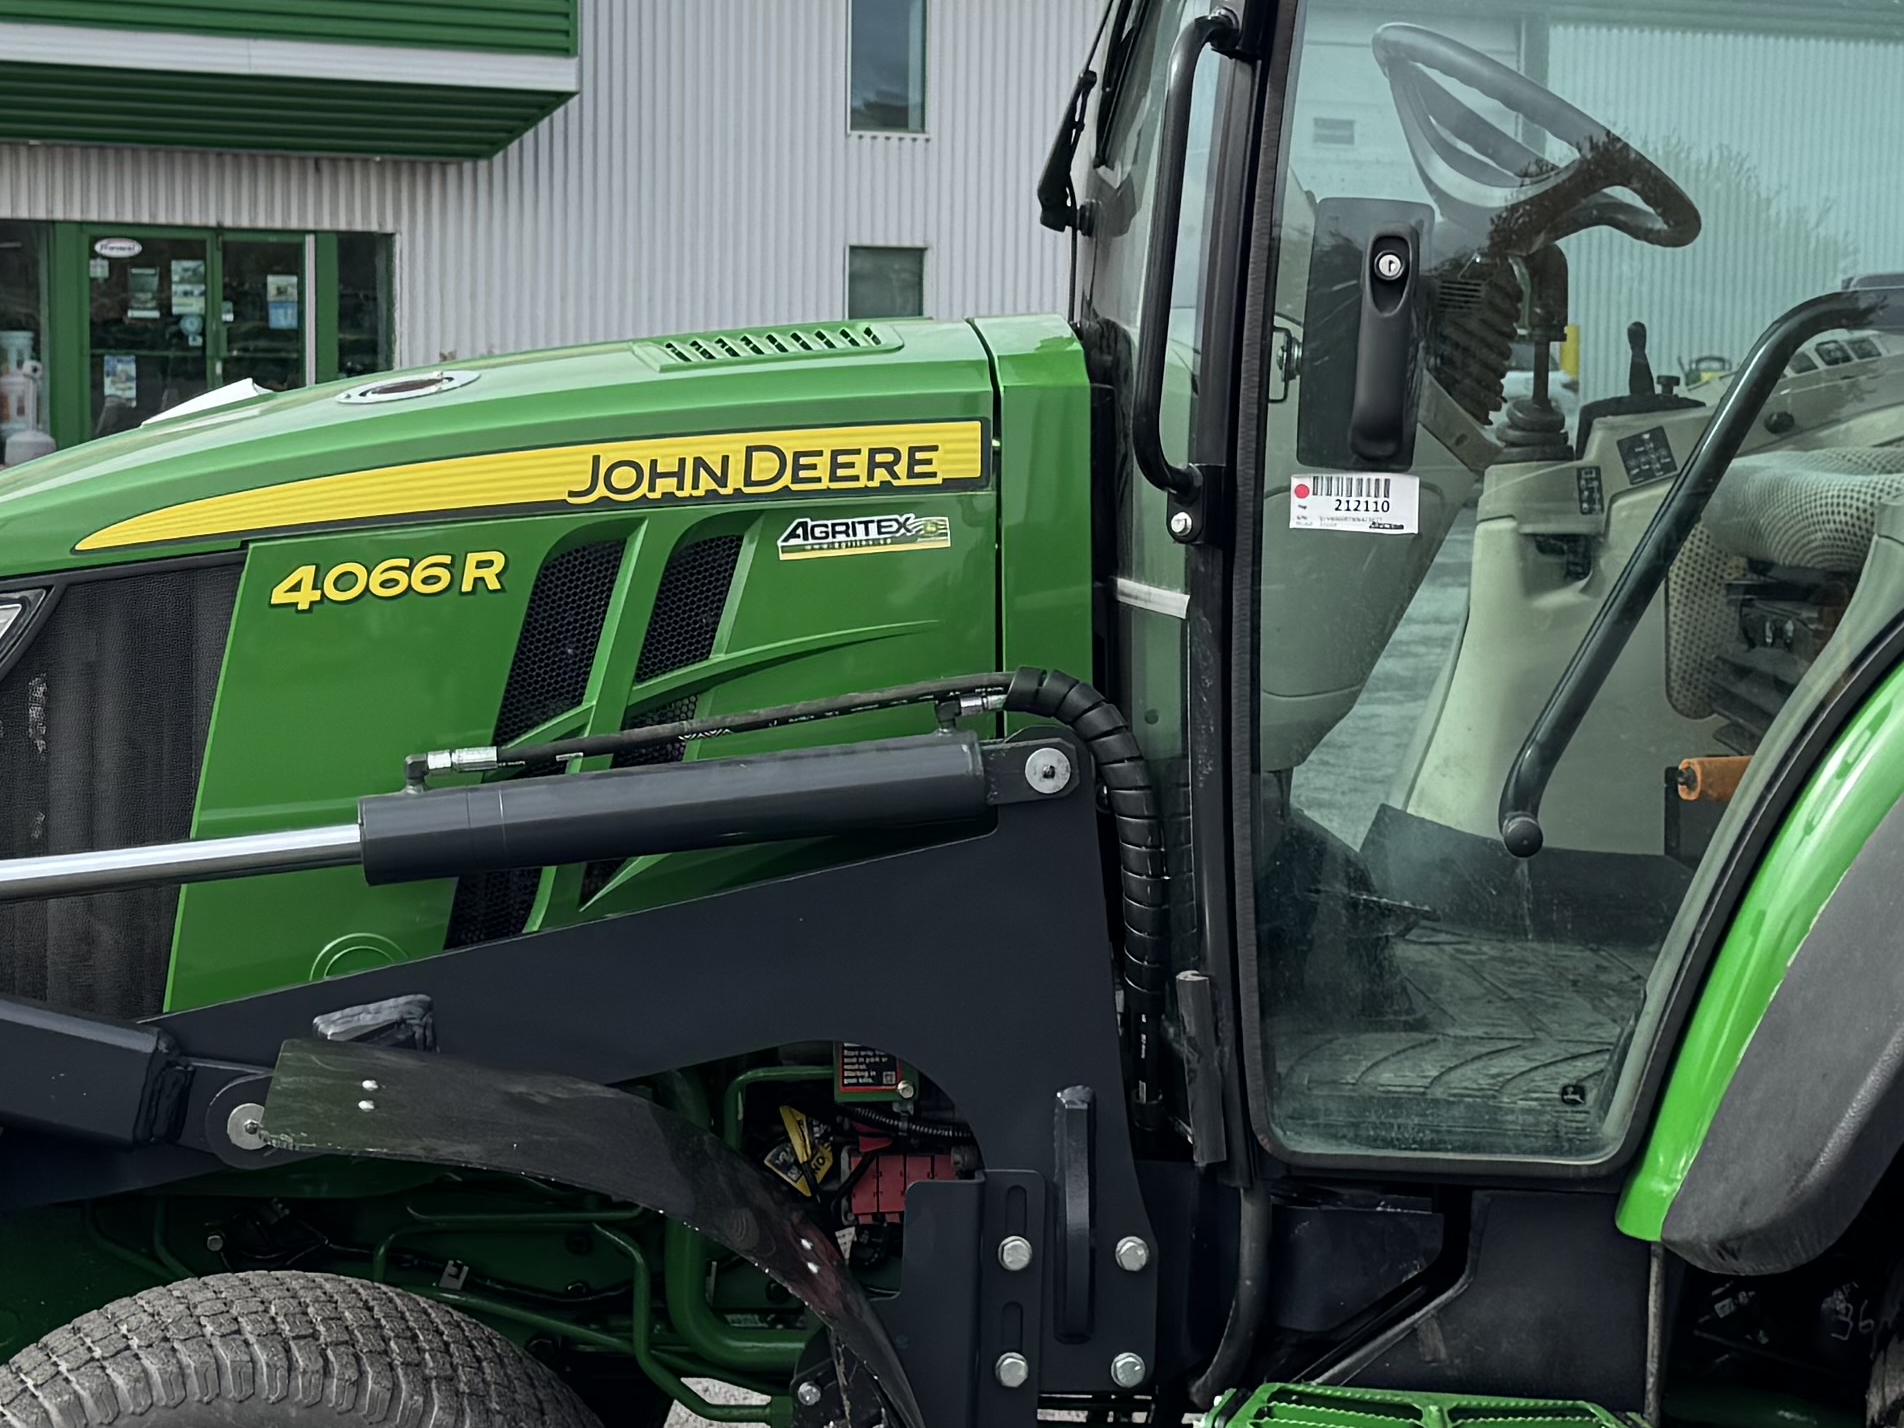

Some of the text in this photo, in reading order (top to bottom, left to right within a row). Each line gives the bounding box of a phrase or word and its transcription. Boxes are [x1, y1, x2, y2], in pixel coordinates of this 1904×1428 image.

[567, 444, 940, 498] JOHN DEERE
[1334, 498, 1390, 513] 212110
[781, 516, 914, 542] AGRITEX
